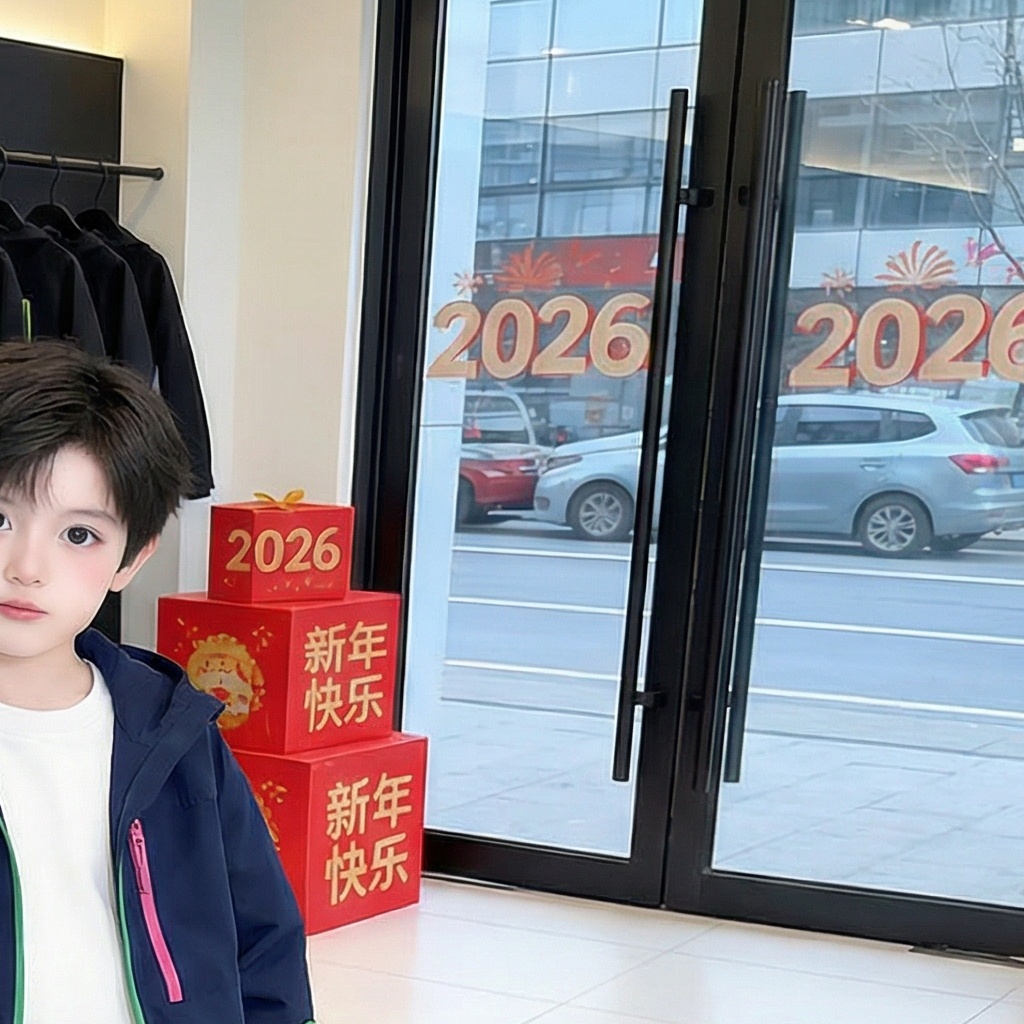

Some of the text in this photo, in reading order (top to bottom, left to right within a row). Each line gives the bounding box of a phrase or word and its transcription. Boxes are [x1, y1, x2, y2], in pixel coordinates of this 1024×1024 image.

[426, 292, 652, 380] 2026
[225, 526, 343, 574] 2026
[304, 620, 388, 675] 新年
[303, 673, 384, 733] 快乐
[326, 772, 413, 841] 新年
[324, 832, 409, 907] 快乐
